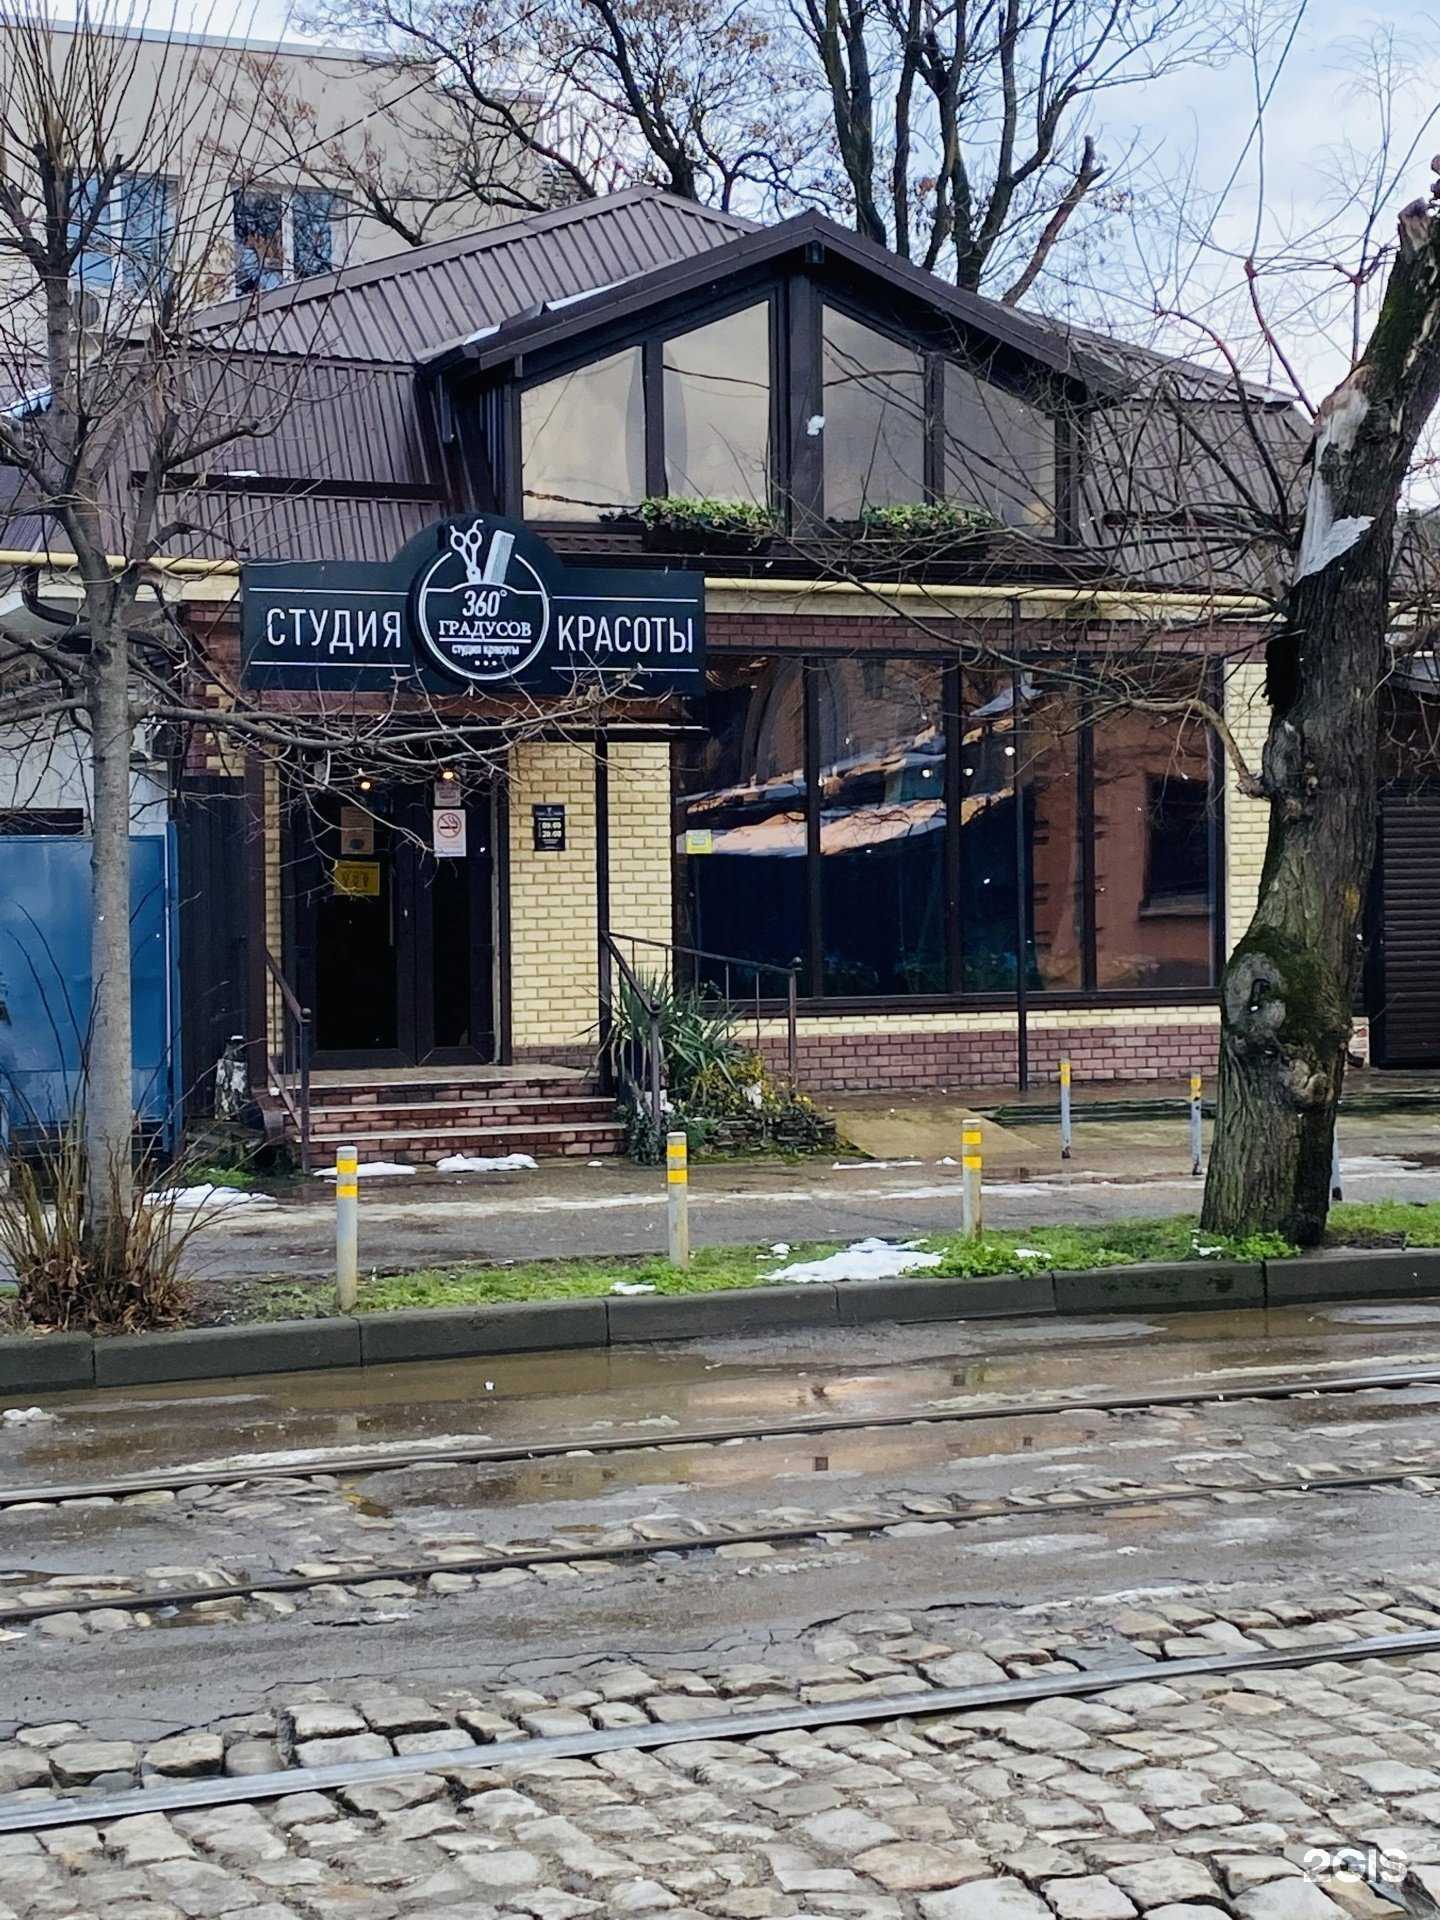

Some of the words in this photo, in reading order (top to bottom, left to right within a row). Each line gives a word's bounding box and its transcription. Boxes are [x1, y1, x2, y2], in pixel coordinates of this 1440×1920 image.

[266, 608, 401, 654] СТУДИЯ
[558, 615, 694, 653] КРАСОТЫ
[439, 620, 532, 640] ГРАДУСОВ
